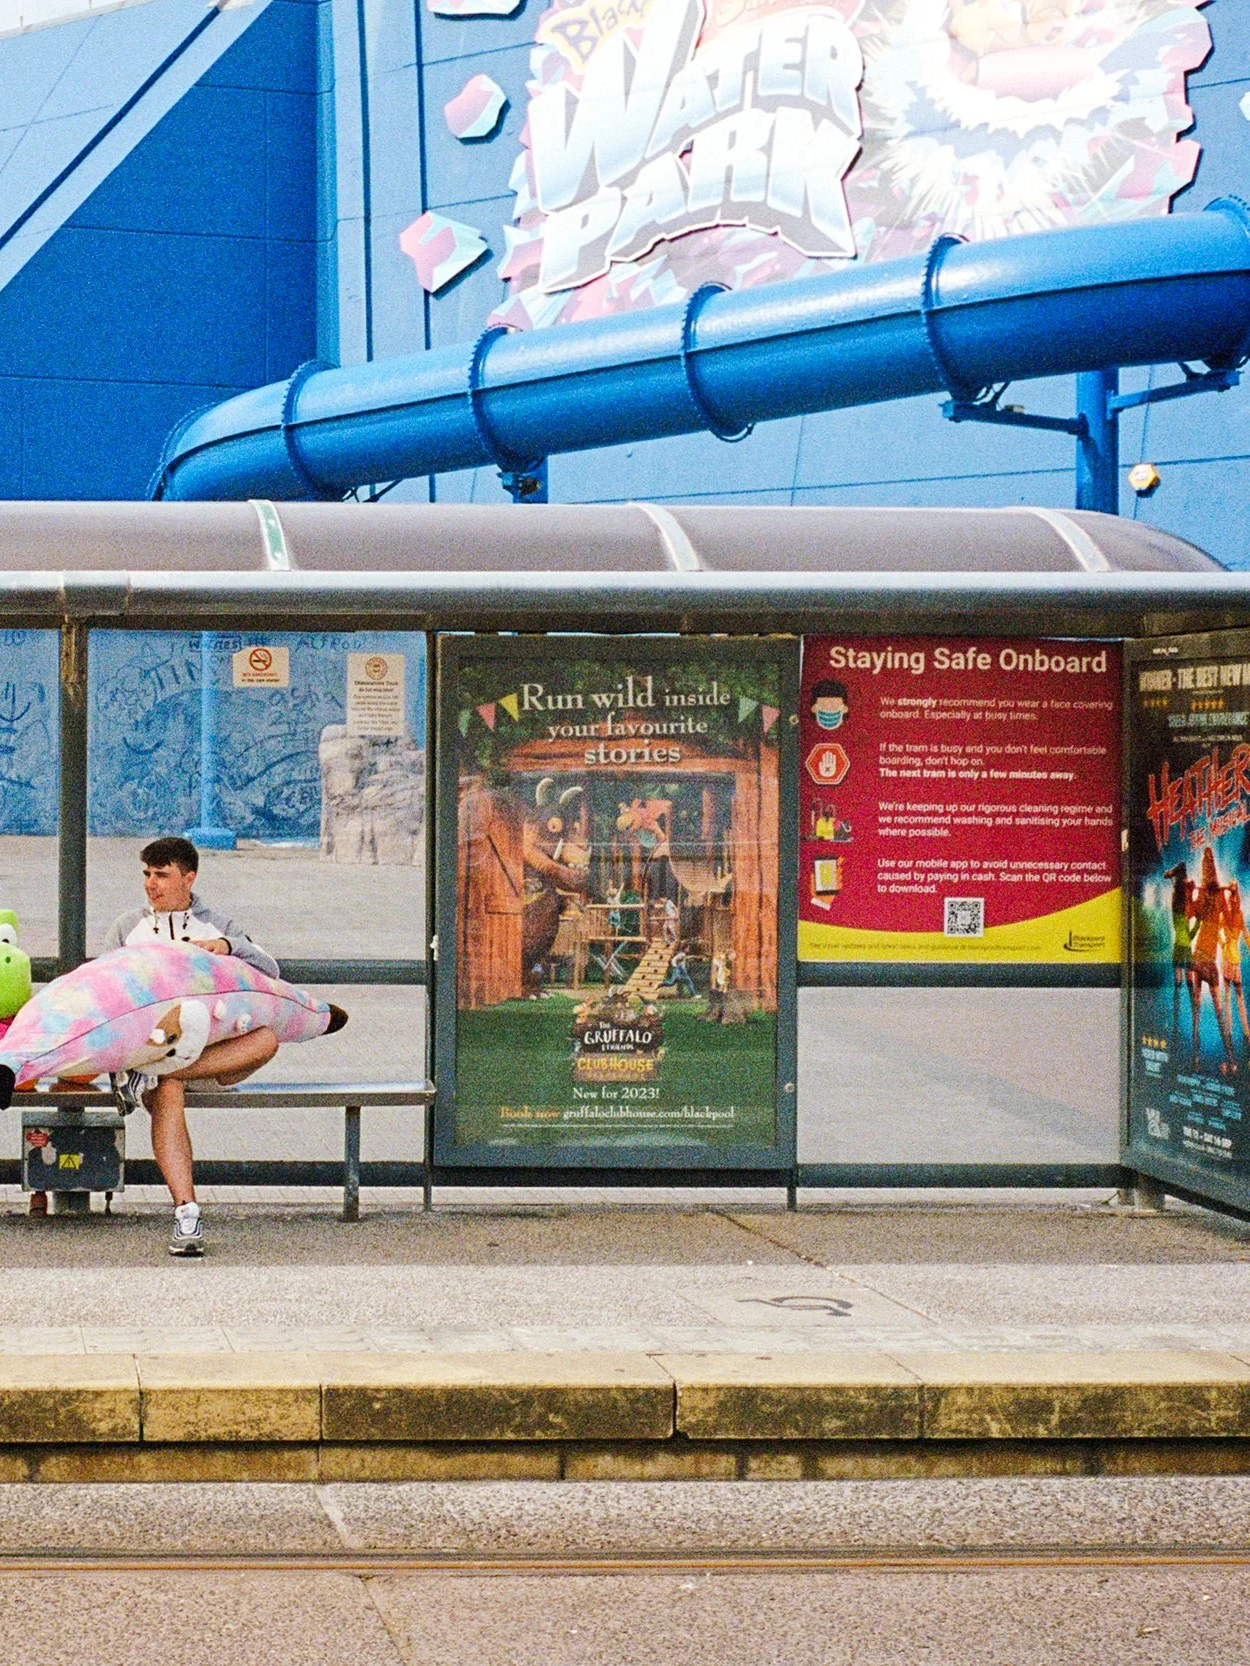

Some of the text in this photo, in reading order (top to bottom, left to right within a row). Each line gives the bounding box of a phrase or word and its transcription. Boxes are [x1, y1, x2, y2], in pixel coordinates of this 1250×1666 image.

[528, 0, 863, 214] WATER
[538, 106, 863, 294] PARK
[829, 646, 1107, 675] Staying Safe Onboard
[520, 676, 731, 711] Run wild inside
[880, 697, 895, 706] We
[897, 697, 937, 708] strongly
[939, 698, 996, 707] recommend
[998, 700, 1015, 709] you
[1017, 700, 1040, 708] wear
[1050, 699, 1071, 708] face
[1073, 700, 1113, 711] covering
[879, 709, 1038, 722] onboard. Especially at busy times.
[548, 711, 708, 742] your favourite
[584, 738, 681, 764] stories
[879, 743, 1107, 755] If the tram is busy and you don't feel comfortable
[879, 756, 923, 766] boarding,
[925, 756, 948, 765] don't
[950, 756, 969, 767] hop
[879, 768, 897, 777] The
[899, 769, 921, 777] next
[923, 769, 946, 778] tram
[947, 769, 956, 778] is
[958, 769, 979, 780] only
[989, 769, 1007, 778] few
[1009, 770, 1048, 779] minutes
[1050, 771, 1077, 782] away.
[879, 802, 904, 811] We're
[906, 802, 944, 813] keeping
[946, 804, 958, 813] up
[977, 803, 1017, 814] rigorous
[1019, 803, 1059, 815] cleaning
[1060, 804, 1093, 814] regime
[1095, 804, 1113, 813] and
[894, 814, 951, 824] recommend
[953, 815, 993, 827] washing
[994, 815, 1013, 825] and
[1015, 816, 1060, 827] sanitising
[1062, 818, 1082, 828] your
[1084, 816, 1113, 826] hands
[878, 827, 951, 838] where possible.
[878, 858, 1106, 872] Use our mobile app to avoid unnecessary contact
[877, 871, 1111, 883] caused by paying in cash. Scan the QR code below
[877, 884, 937, 893] to download.
[583, 1029, 652, 1045] GRUFFALO
[577, 1056, 654, 1073] CLUBHOUSE
[573, 1085, 660, 1099] New for 2023!
[500, 1105, 734, 1120] Book now gruffaloclubhouse.com/blackpool
